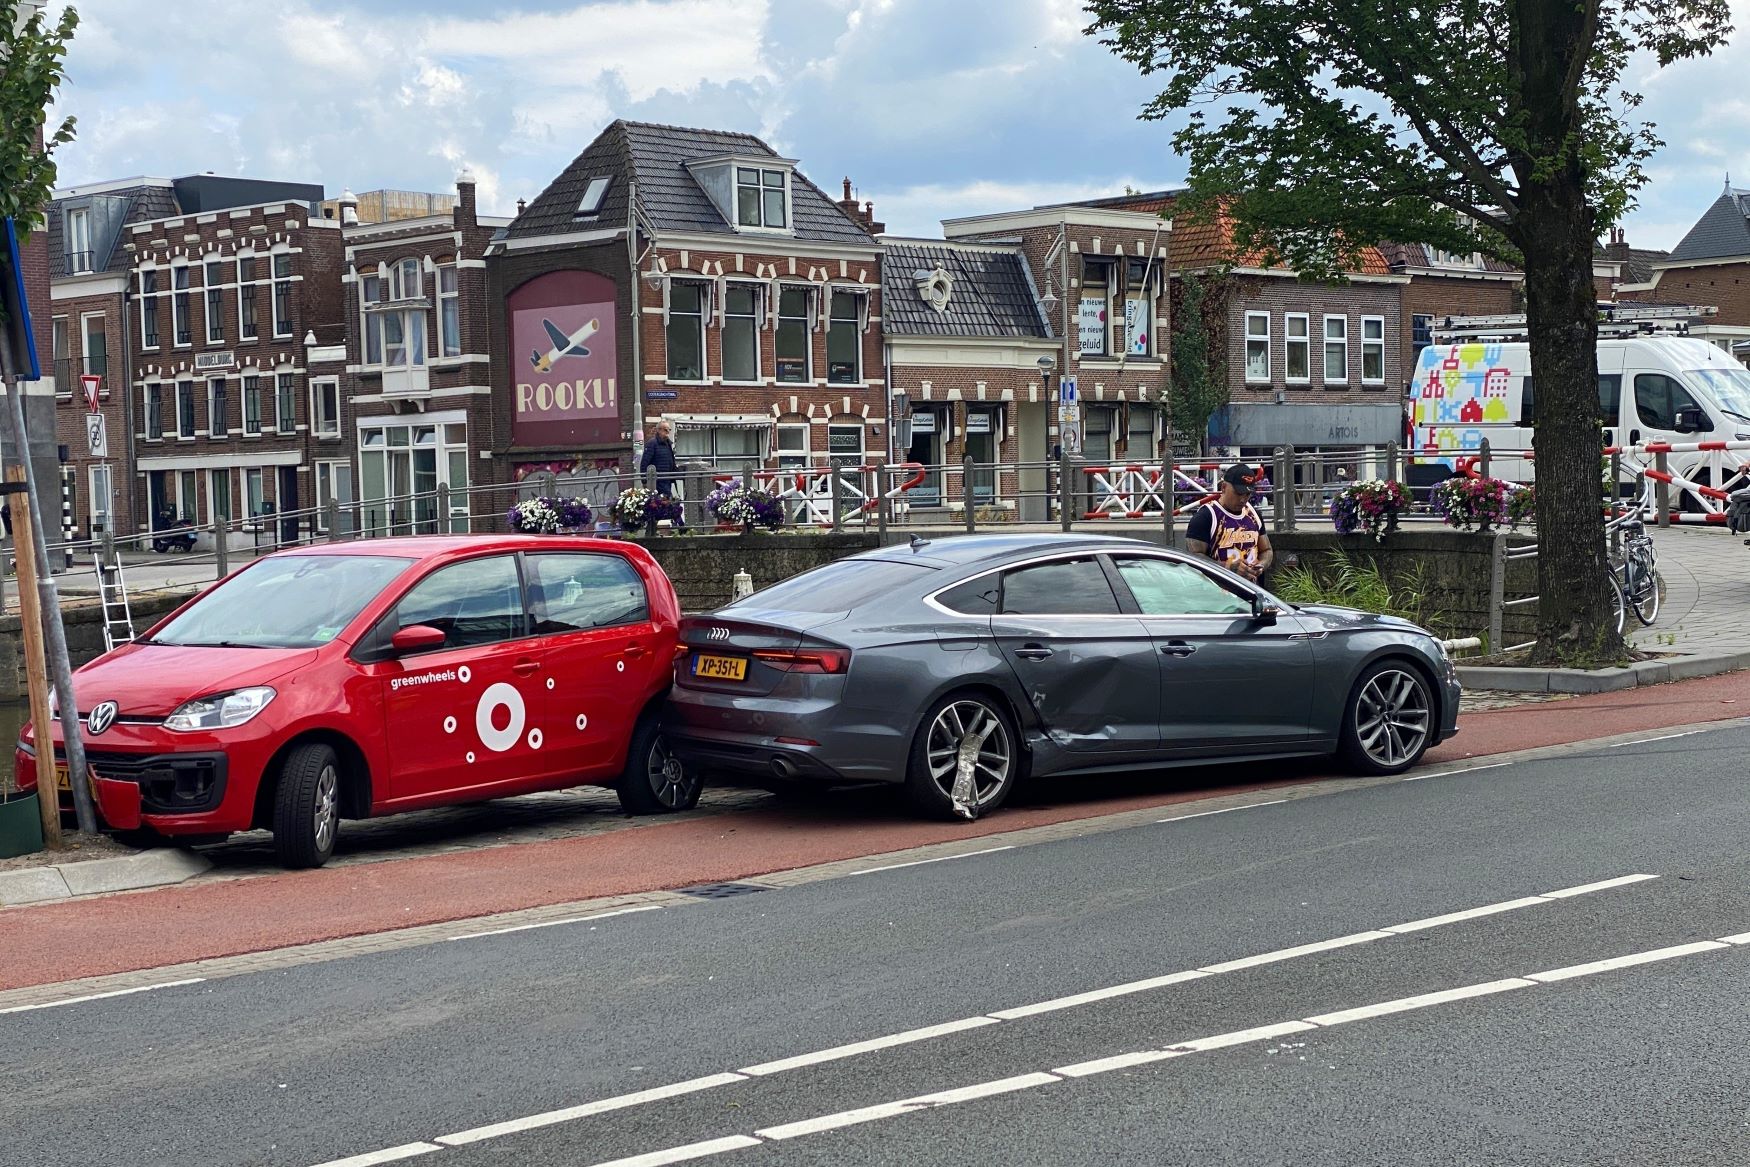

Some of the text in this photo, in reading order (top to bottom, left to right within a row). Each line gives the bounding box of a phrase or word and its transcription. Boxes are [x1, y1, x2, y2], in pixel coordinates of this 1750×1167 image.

[1082, 310, 1098, 319] lente,
[1328, 426, 1359, 439] ARTOIS
[701, 658, 740, 677] XP-351-L
[391, 669, 456, 691] greenwheels
